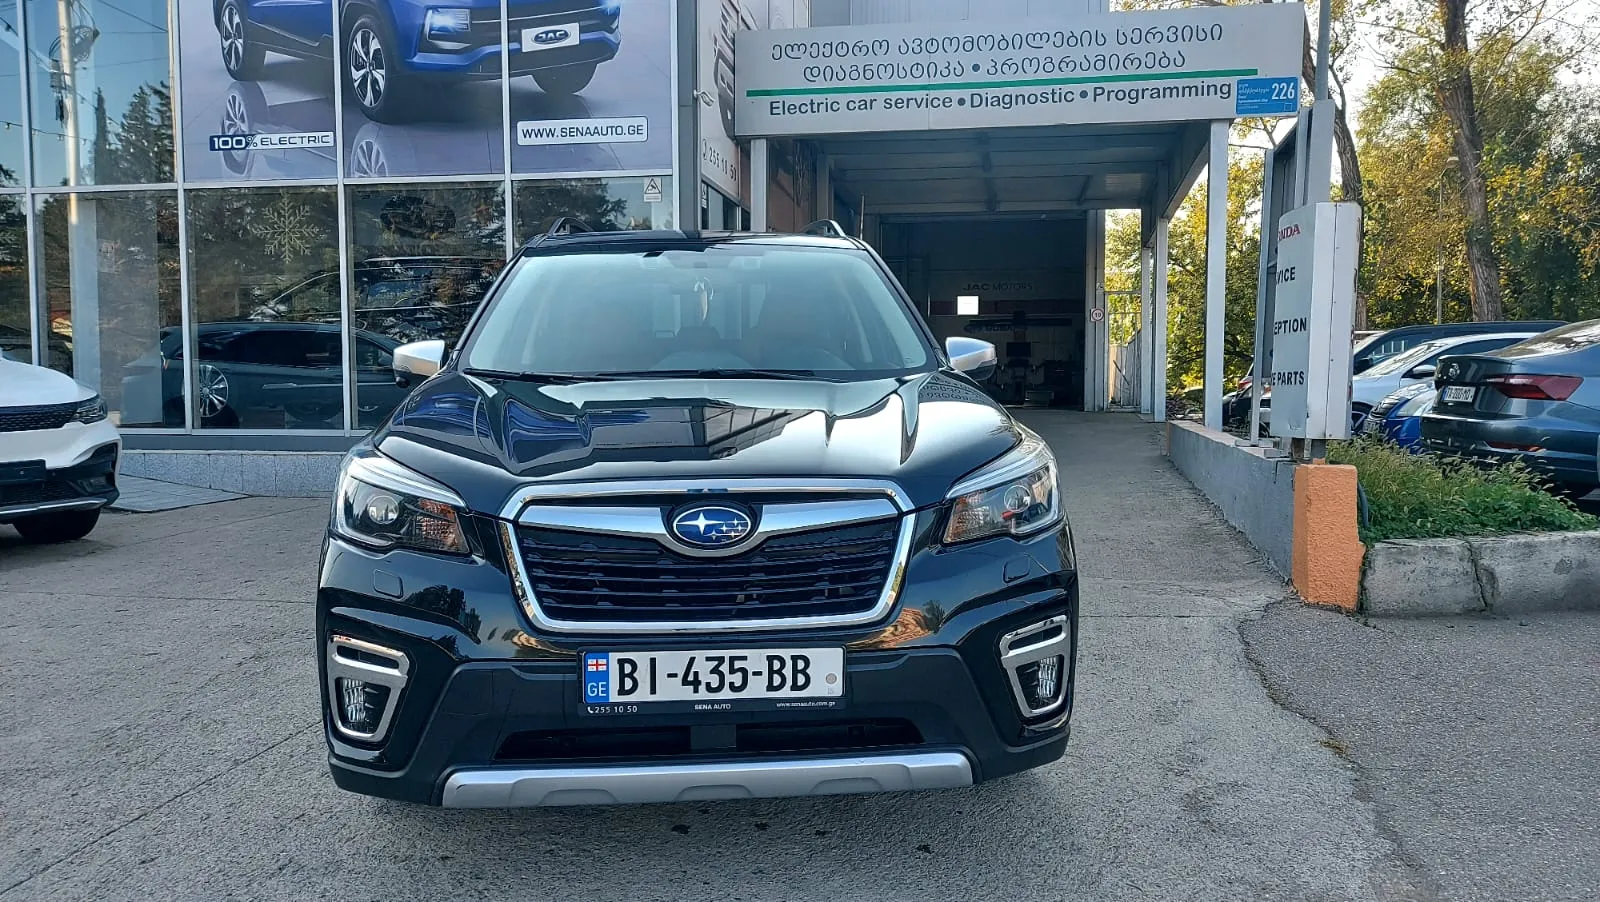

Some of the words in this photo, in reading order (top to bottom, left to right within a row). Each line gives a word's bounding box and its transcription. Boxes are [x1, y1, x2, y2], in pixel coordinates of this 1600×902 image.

[538, 30, 565, 41] JAC
[772, 39, 890, 60] ელექტრო
[898, 29, 1107, 55] ავტომობილების
[1116, 23, 1223, 46] სერვისი
[803, 60, 965, 82] დიაგნოსტიკა
[986, 50, 1186, 76] პროგრამირება
[769, 98, 841, 116] Electric
[846, 99, 878, 112] car
[883, 93, 953, 110] service
[970, 87, 1075, 110] Diagnostic
[1093, 80, 1232, 105] Programming
[1271, 82, 1295, 100] 226
[521, 124, 644, 139] WWW.SENAAUTO.GE
[213, 135, 258, 150] 100%
[260, 134, 330, 146] ELECTRIC
[962, 283, 990, 291] JAC
[1277, 370, 1305, 386] PARTS
[617, 655, 811, 696] BI-435-BB
[587, 682, 607, 697] GE
[614, 705, 624, 713] 10
